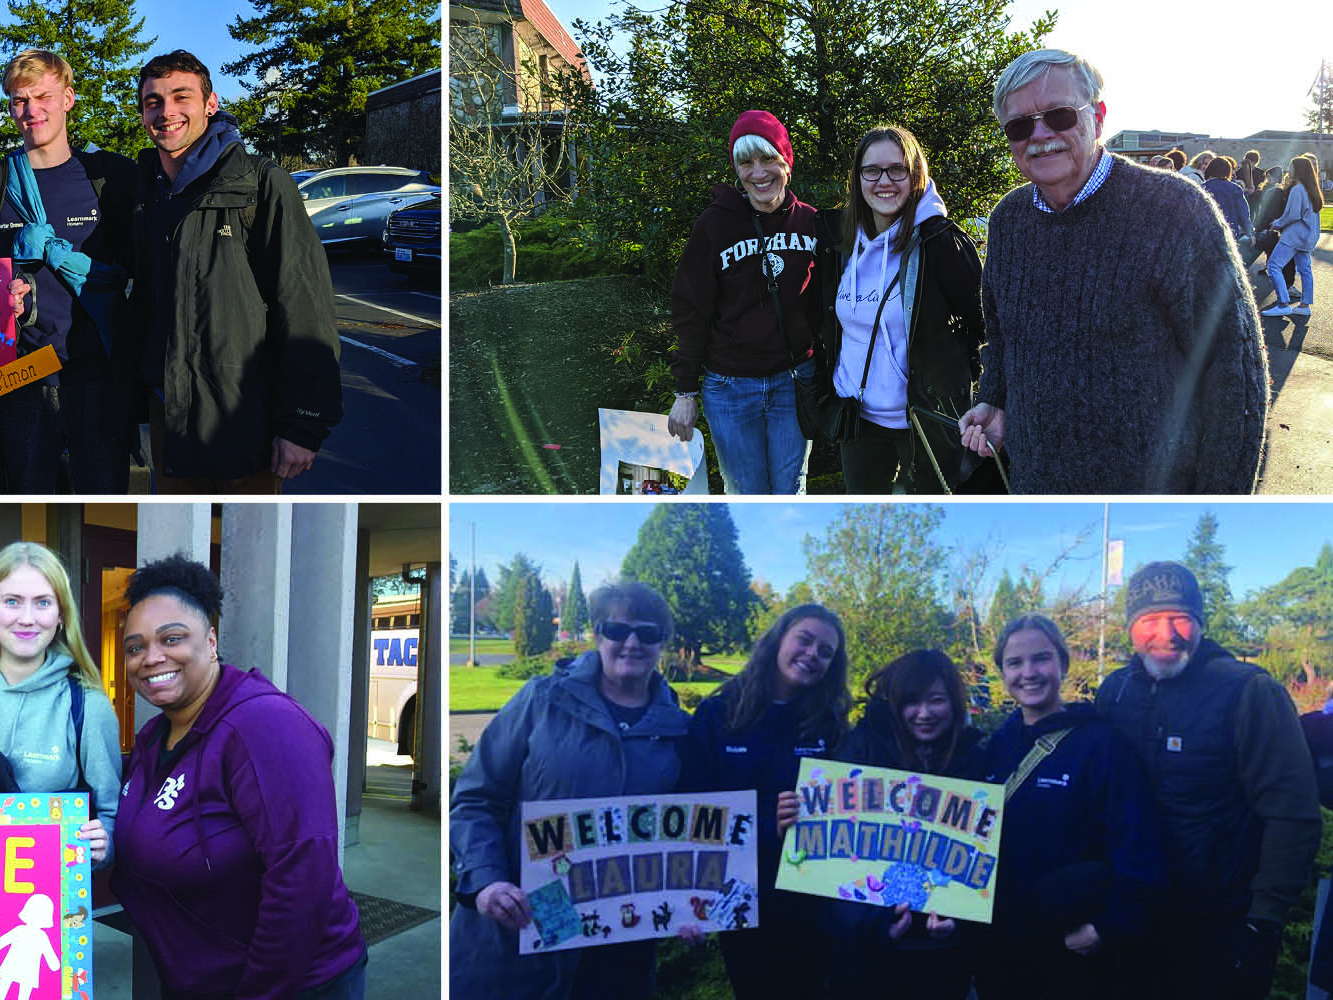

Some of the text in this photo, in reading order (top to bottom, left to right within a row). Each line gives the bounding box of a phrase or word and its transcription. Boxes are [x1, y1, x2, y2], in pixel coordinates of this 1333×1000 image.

[67, 215, 98, 223] Learnmark
[374, 638, 419, 666] TAC
[528, 804, 753, 855] WELCOME
[800, 780, 997, 838] WELCOME
[571, 853, 722, 899] LAURA
[797, 821, 994, 888] MATHILDE
